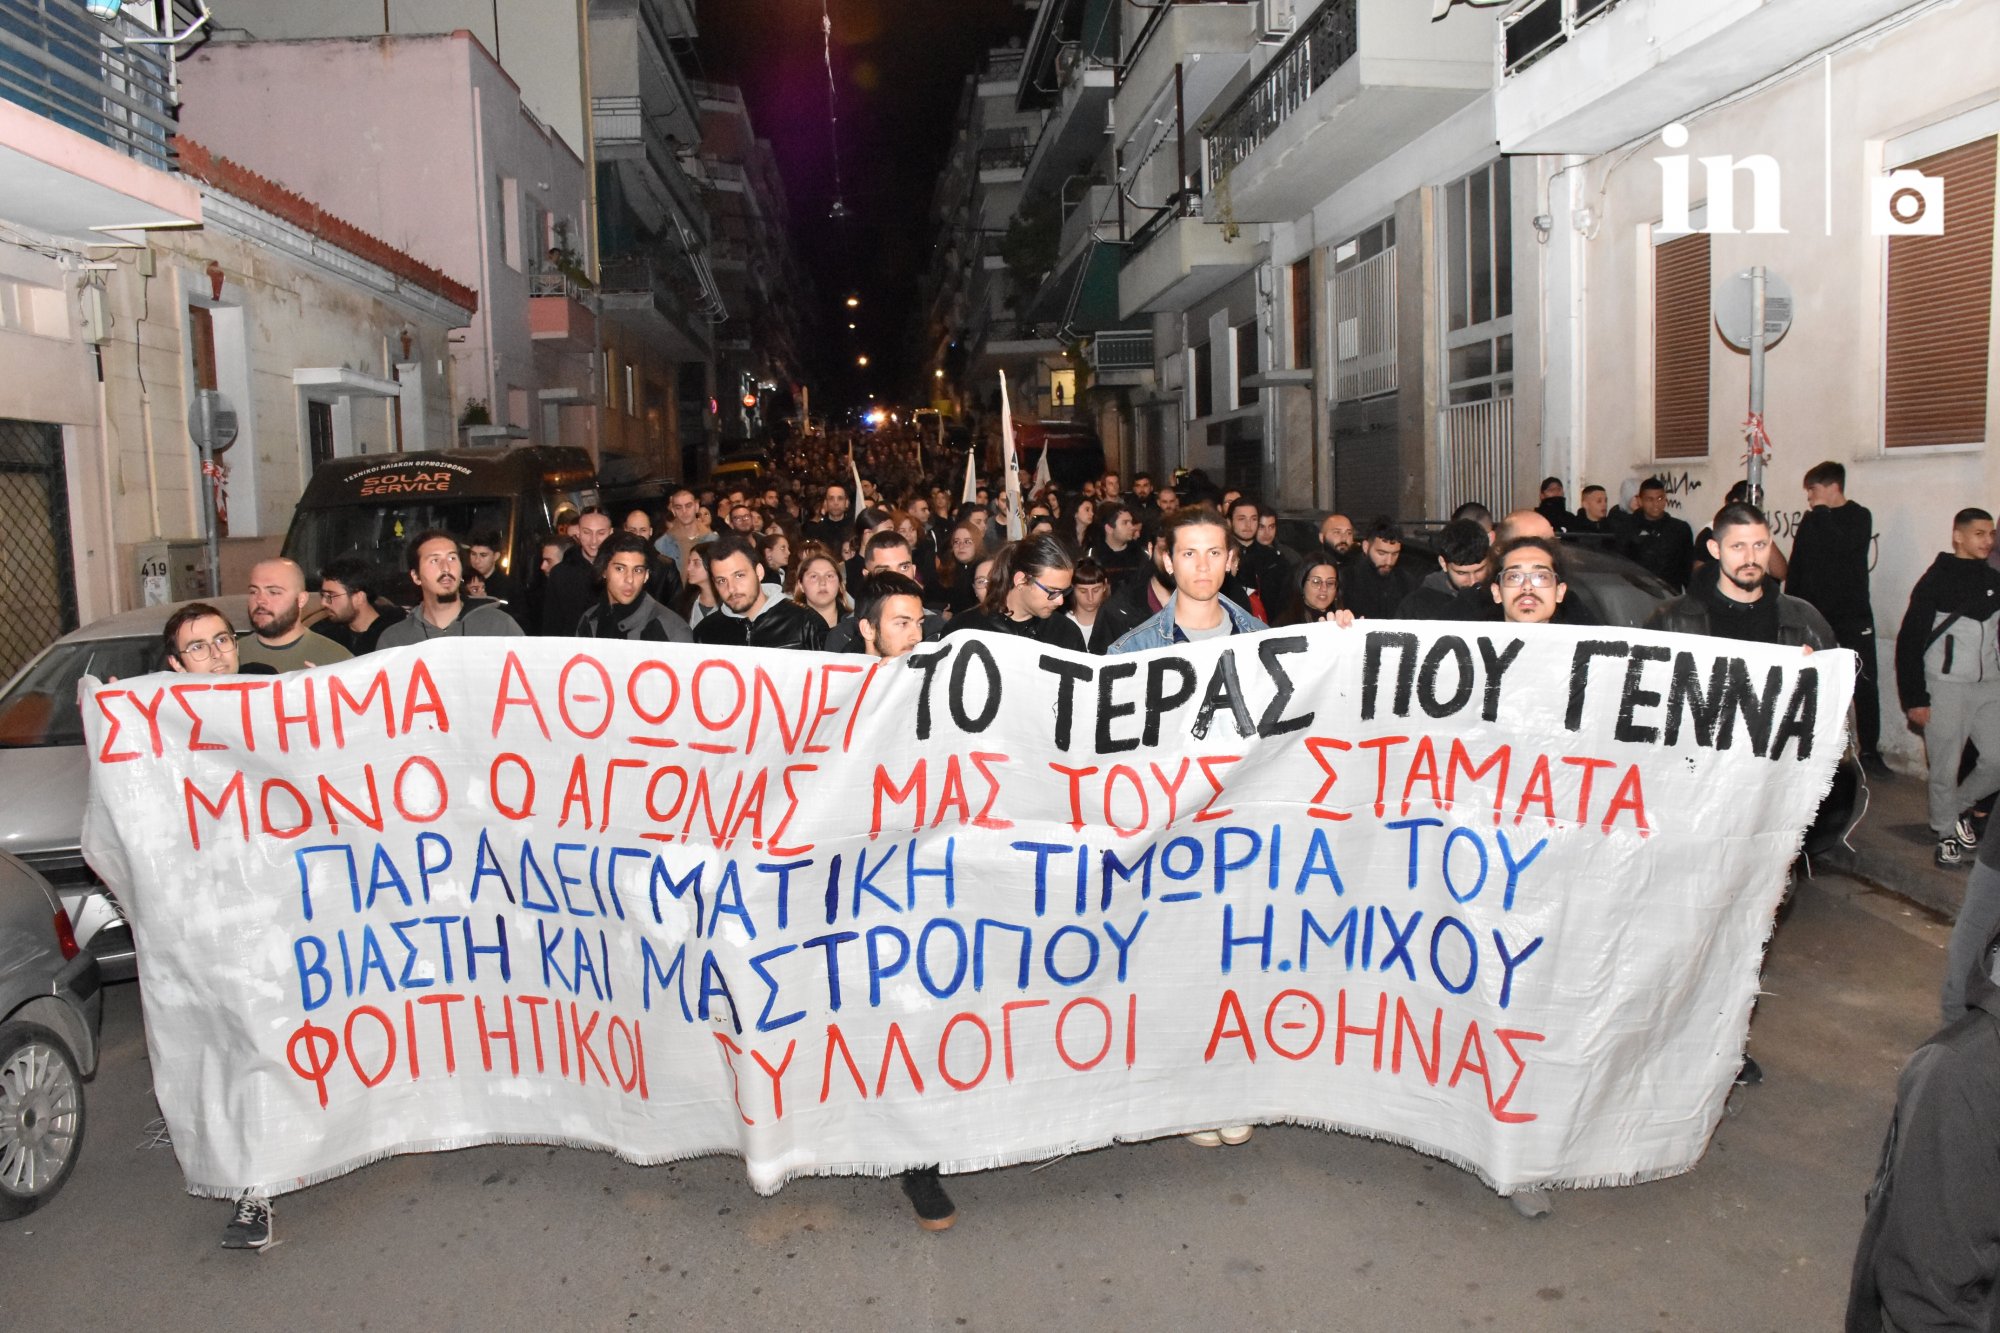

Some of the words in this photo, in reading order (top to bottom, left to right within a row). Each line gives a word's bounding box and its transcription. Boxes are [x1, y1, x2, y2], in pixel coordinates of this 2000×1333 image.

[344, 466, 379, 483] ΤΕΧΝΙΚΟΙ
[380, 461, 414, 470] ΗΛΙΑΚΩΝ
[360, 482, 450, 497] SERVICE
[363, 472, 451, 487] SOLAR
[141, 562, 167, 577] 419
[95, 657, 450, 764] ΣΥΣΤΗΜΑ
[907, 639, 1003, 742] ΤΟ
[1039, 635, 1316, 755] ΤΕΡΑΣ
[1360, 631, 1525, 723] ΠΟΥ
[1564, 639, 1819, 762] ΓΕΝΝΑ
[183, 754, 449, 851] ΜΟΝΟ
[490, 751, 536, 821] Ο
[557, 752, 820, 858] ΑΓΩΝΑΣ
[869, 751, 1015, 841] ΜΑΣ
[1048, 755, 1245, 839] ΤΟΥΣ
[1304, 735, 1651, 839] ΣΤΑΜΑΤΑ
[293, 827, 956, 941] ΠΑΡΑΔΕΙΓΜΑΤΙΚΗ
[1010, 823, 1345, 919] ΤΙΜΩΡΙΑ
[1384, 817, 1550, 912] ΤΟΥ
[293, 913, 512, 1012] ΒΙΑΣΤΗ
[537, 918, 613, 1002] ΚΑΙ
[639, 908, 1150, 1035] ΜΑΣΤΡΟΠΟΥ
[285, 993, 650, 1110] ΦΟΙΤΗΤΙΚΟΙ
[1203, 988, 1546, 1124] ΑΘΗΝΑΣ
